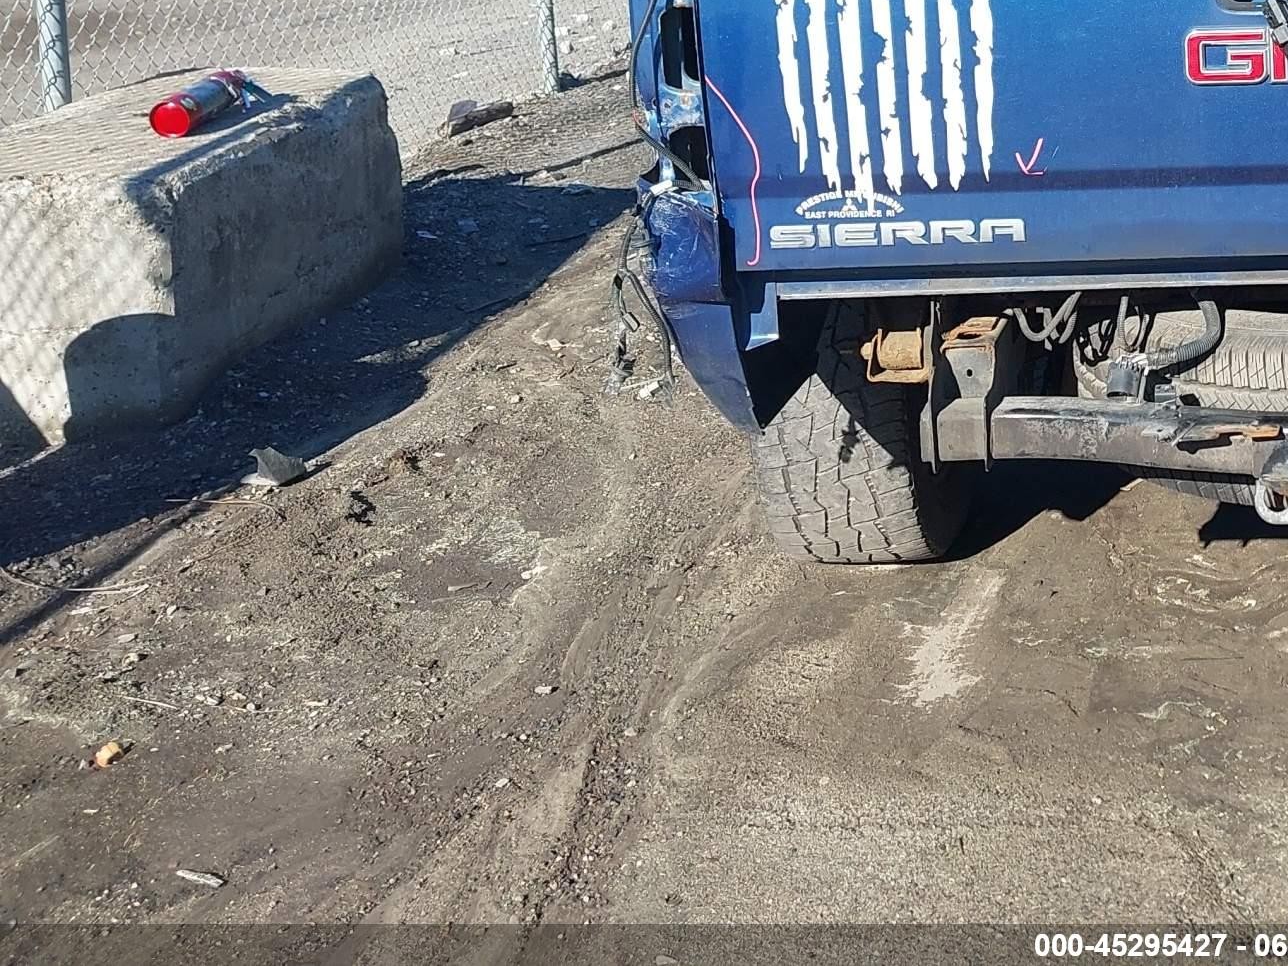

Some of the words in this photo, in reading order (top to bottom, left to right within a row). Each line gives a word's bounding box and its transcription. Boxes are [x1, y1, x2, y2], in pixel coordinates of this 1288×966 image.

[805, 210, 828, 219] EAST
[828, 209, 882, 218] PROVIDENCE
[886, 209, 896, 217] RI
[769, 218, 1026, 249] SIERRA
